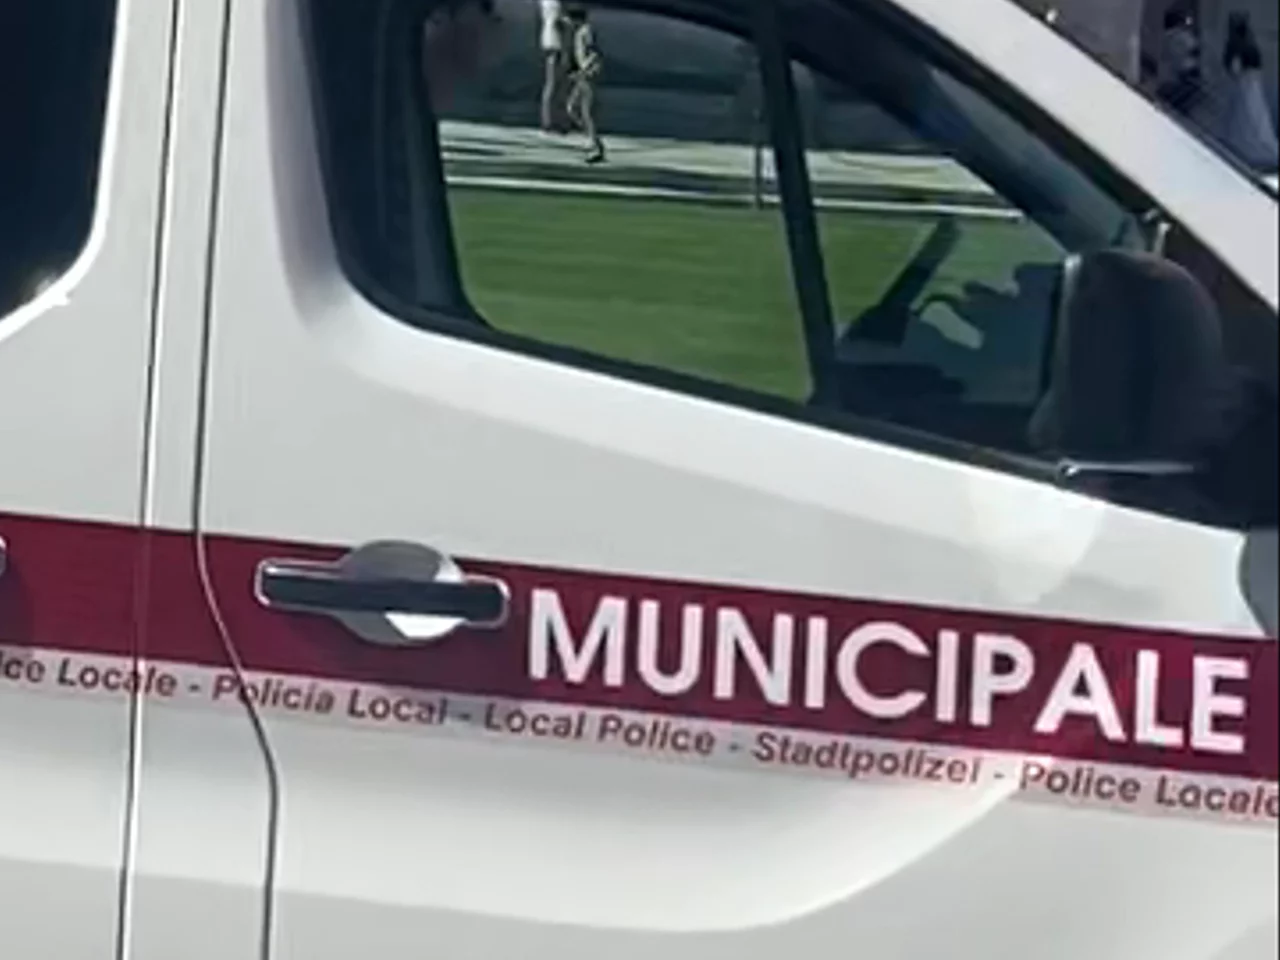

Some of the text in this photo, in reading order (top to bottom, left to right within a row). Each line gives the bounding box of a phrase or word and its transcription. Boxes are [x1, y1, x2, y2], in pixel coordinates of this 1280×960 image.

[58, 658, 177, 697] Locale
[347, 688, 447, 725] Local
[484, 703, 586, 739] Local
[598, 713, 715, 757] Police
[752, 731, 982, 783] Stadtpolizei
[1019, 760, 1141, 803] Police
[529, 588, 1249, 753] MUNICIPALE
